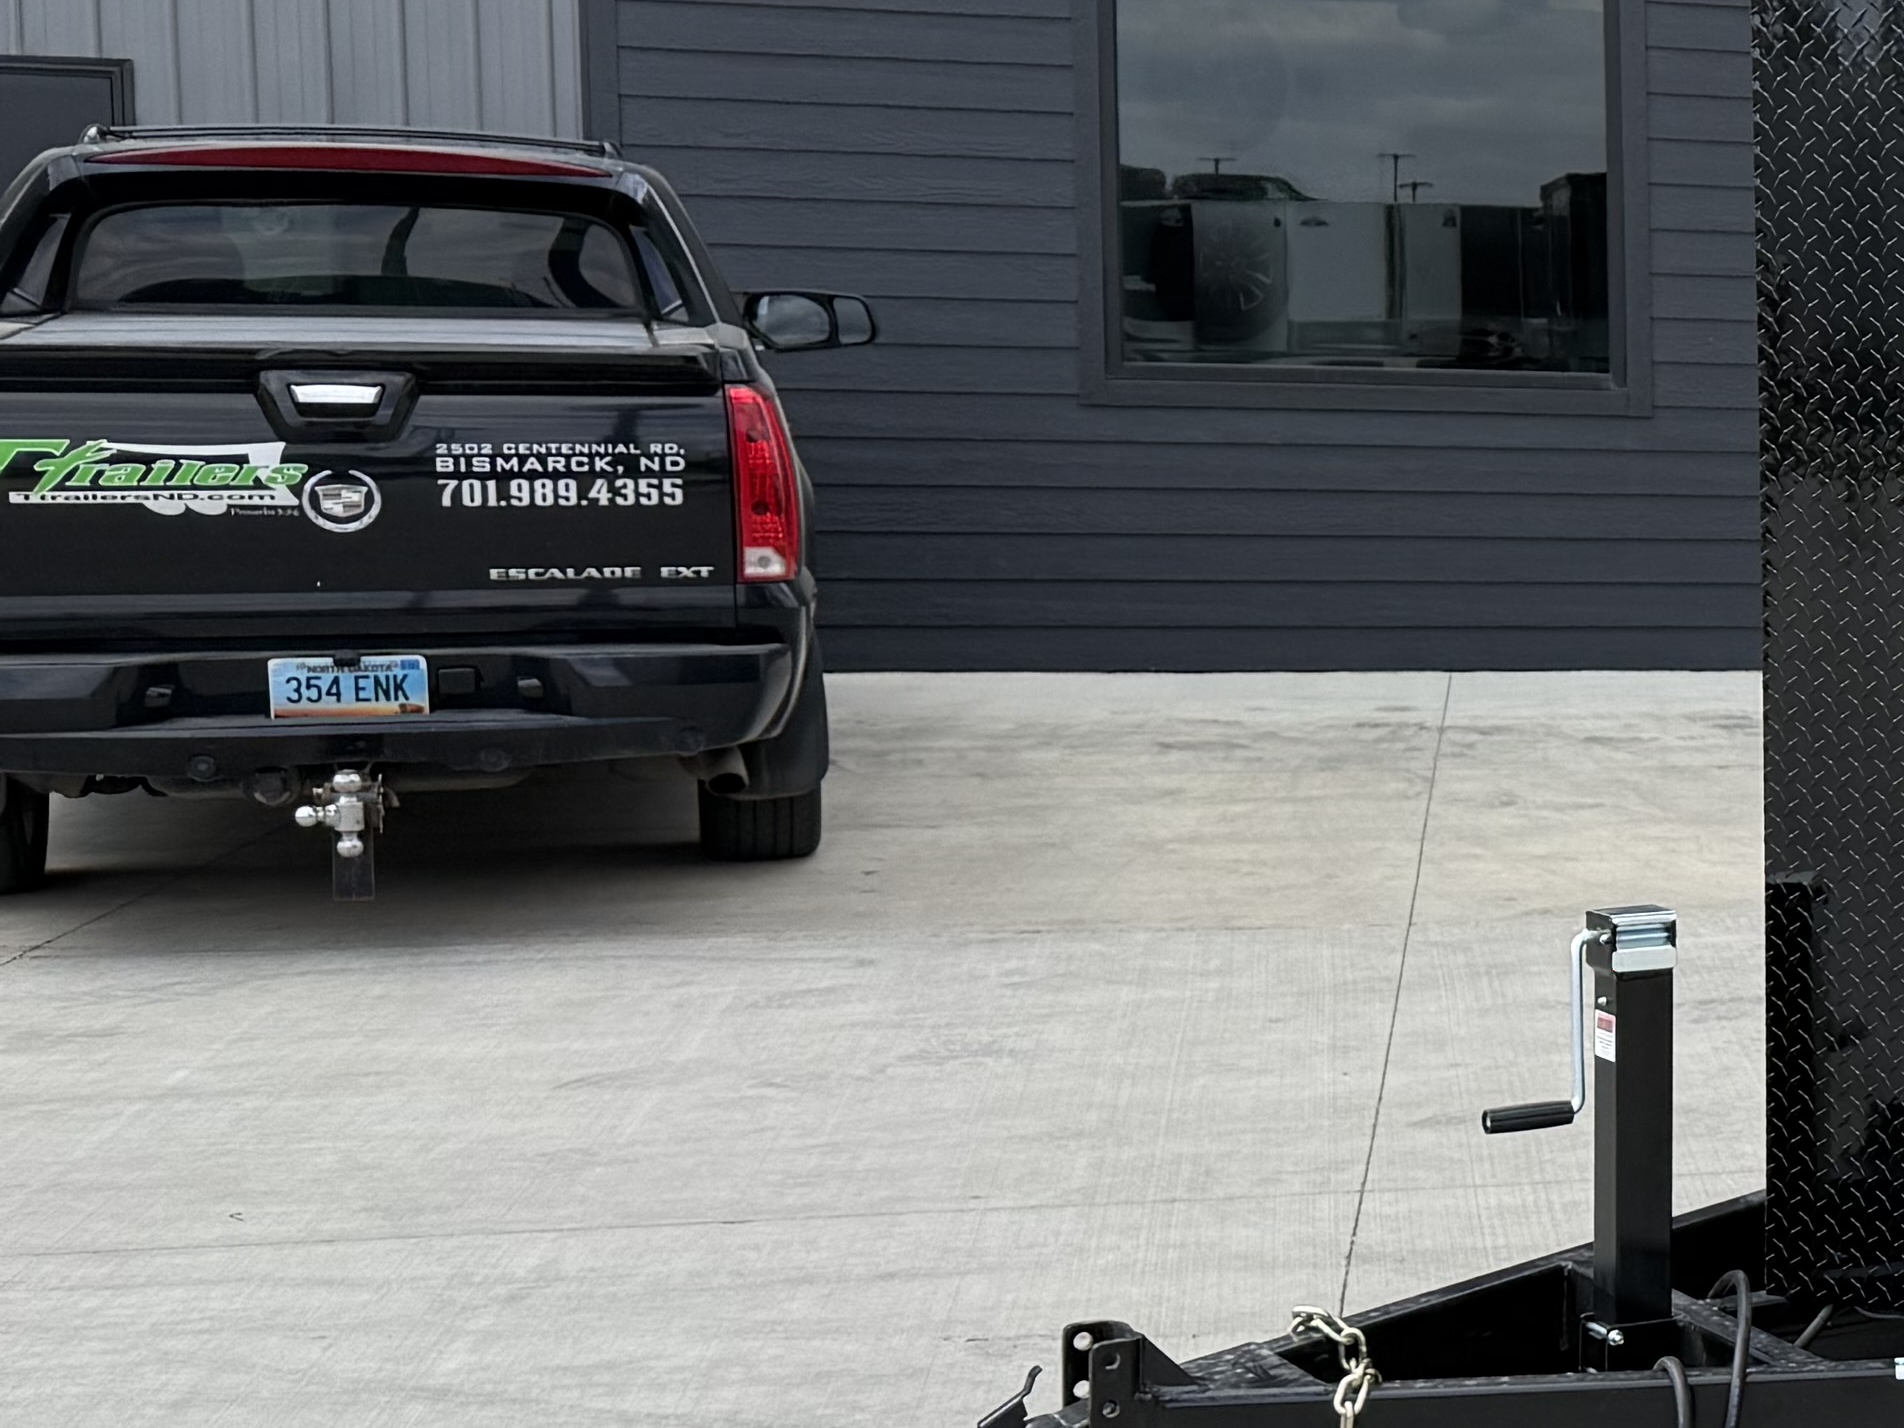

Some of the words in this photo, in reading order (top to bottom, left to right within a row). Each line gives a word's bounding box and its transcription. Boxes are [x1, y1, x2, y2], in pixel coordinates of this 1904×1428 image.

[435, 443, 494, 455] 2502
[502, 443, 642, 454] CENTENNIAL
[435, 456, 624, 474] BISMARCK,
[640, 456, 686, 472] ND
[437, 478, 684, 507] 701.989.4355
[489, 566, 643, 580] ESCALADE
[660, 566, 714, 578] EXT
[285, 675, 342, 704] 354
[354, 673, 410, 702] ENK
